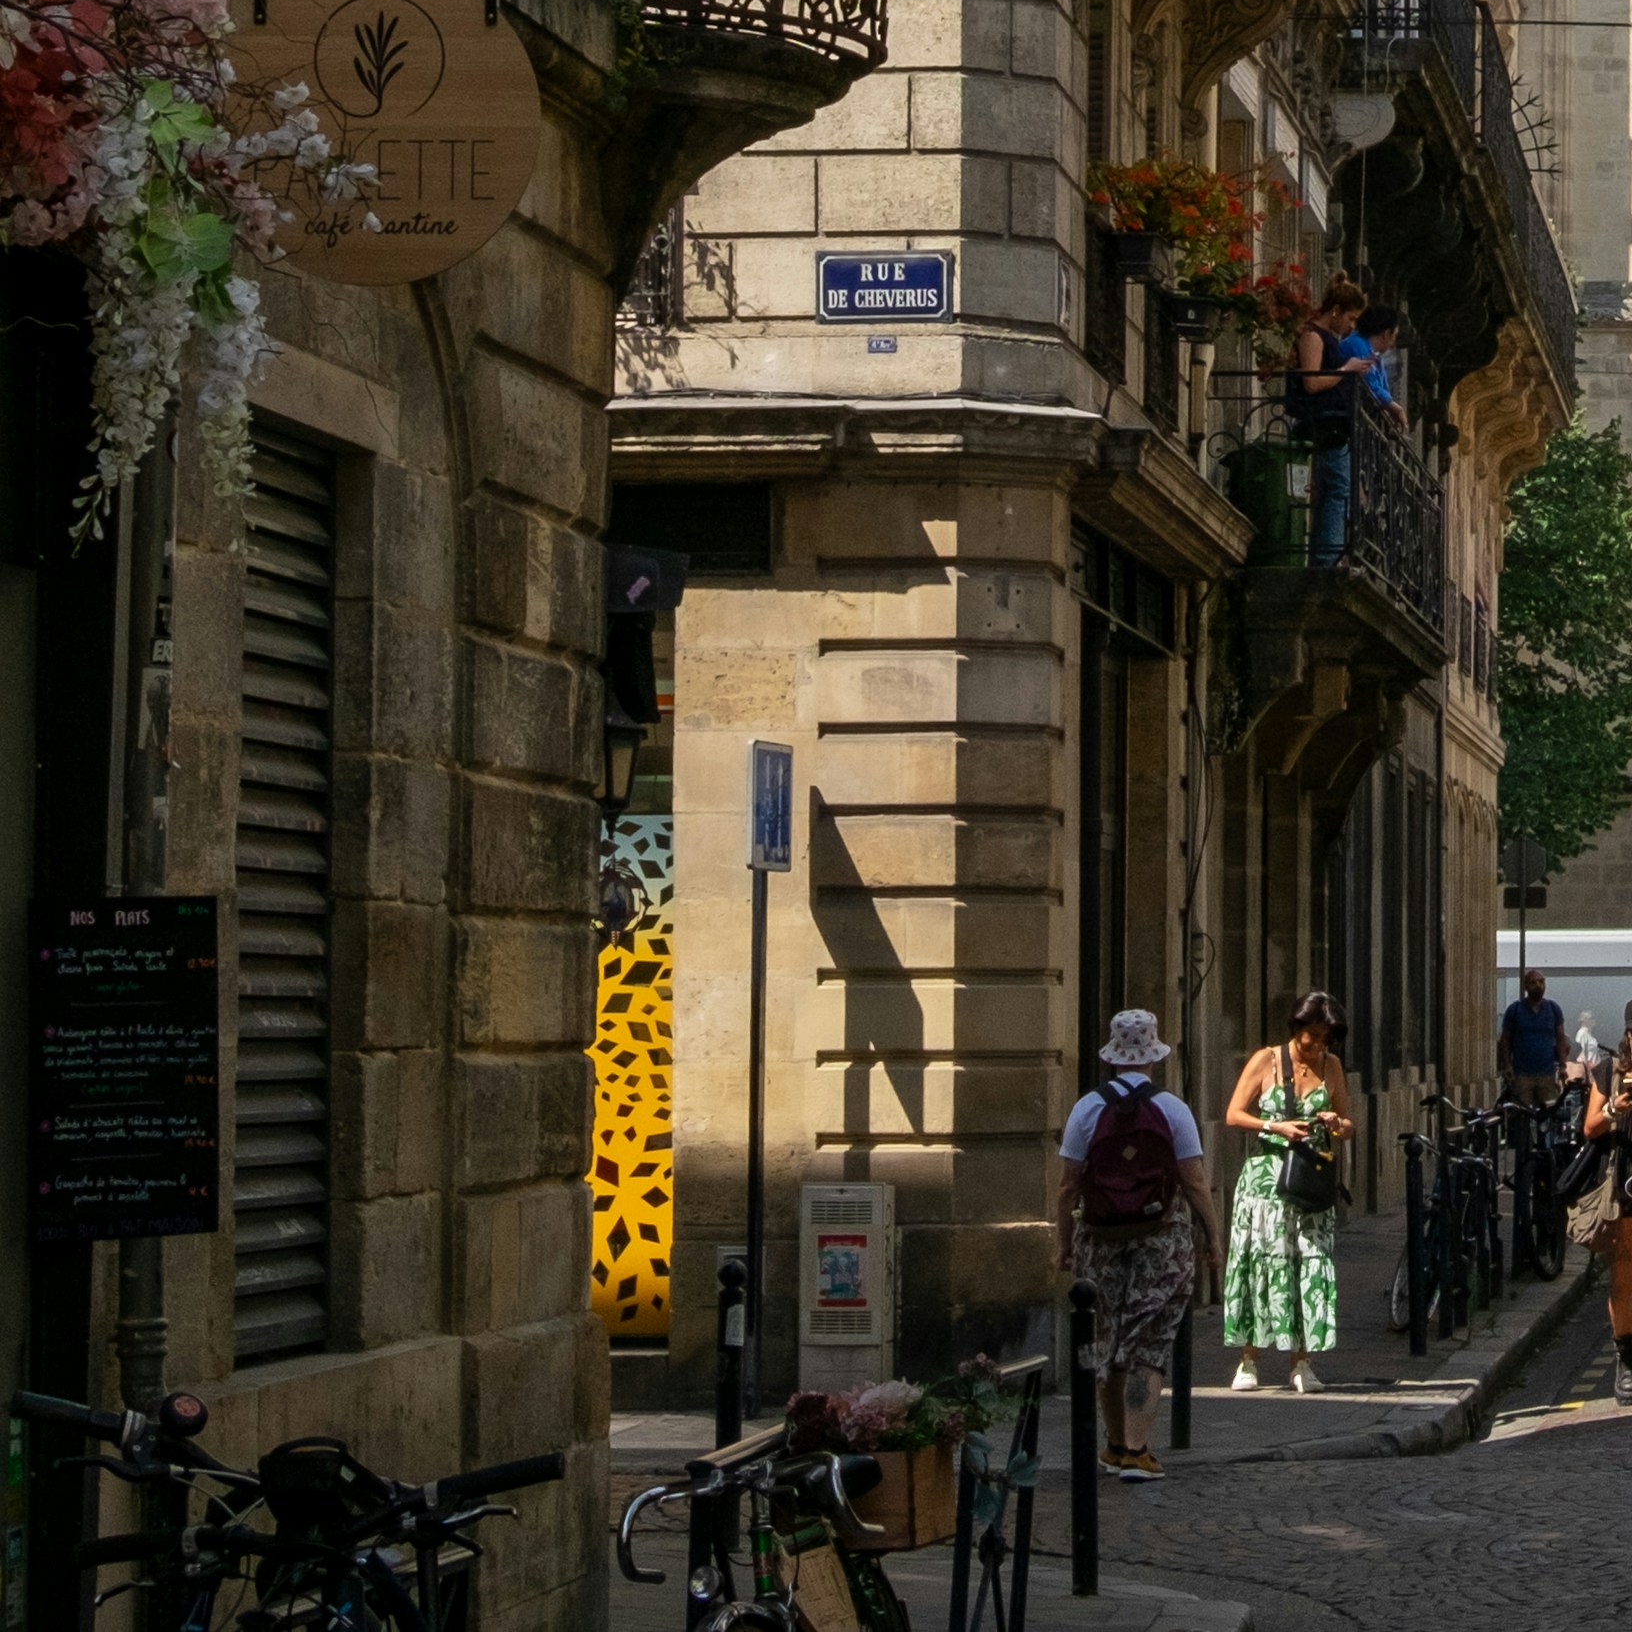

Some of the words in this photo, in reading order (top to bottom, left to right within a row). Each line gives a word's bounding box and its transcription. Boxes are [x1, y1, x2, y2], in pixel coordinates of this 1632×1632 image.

[304, 213, 351, 248] café
[860, 263, 905, 281] RUE
[828, 289, 848, 309] DE
[855, 288, 938, 308] CHEVERUS
[70, 910, 96, 926] NOS
[114, 909, 151, 926] PLATS
